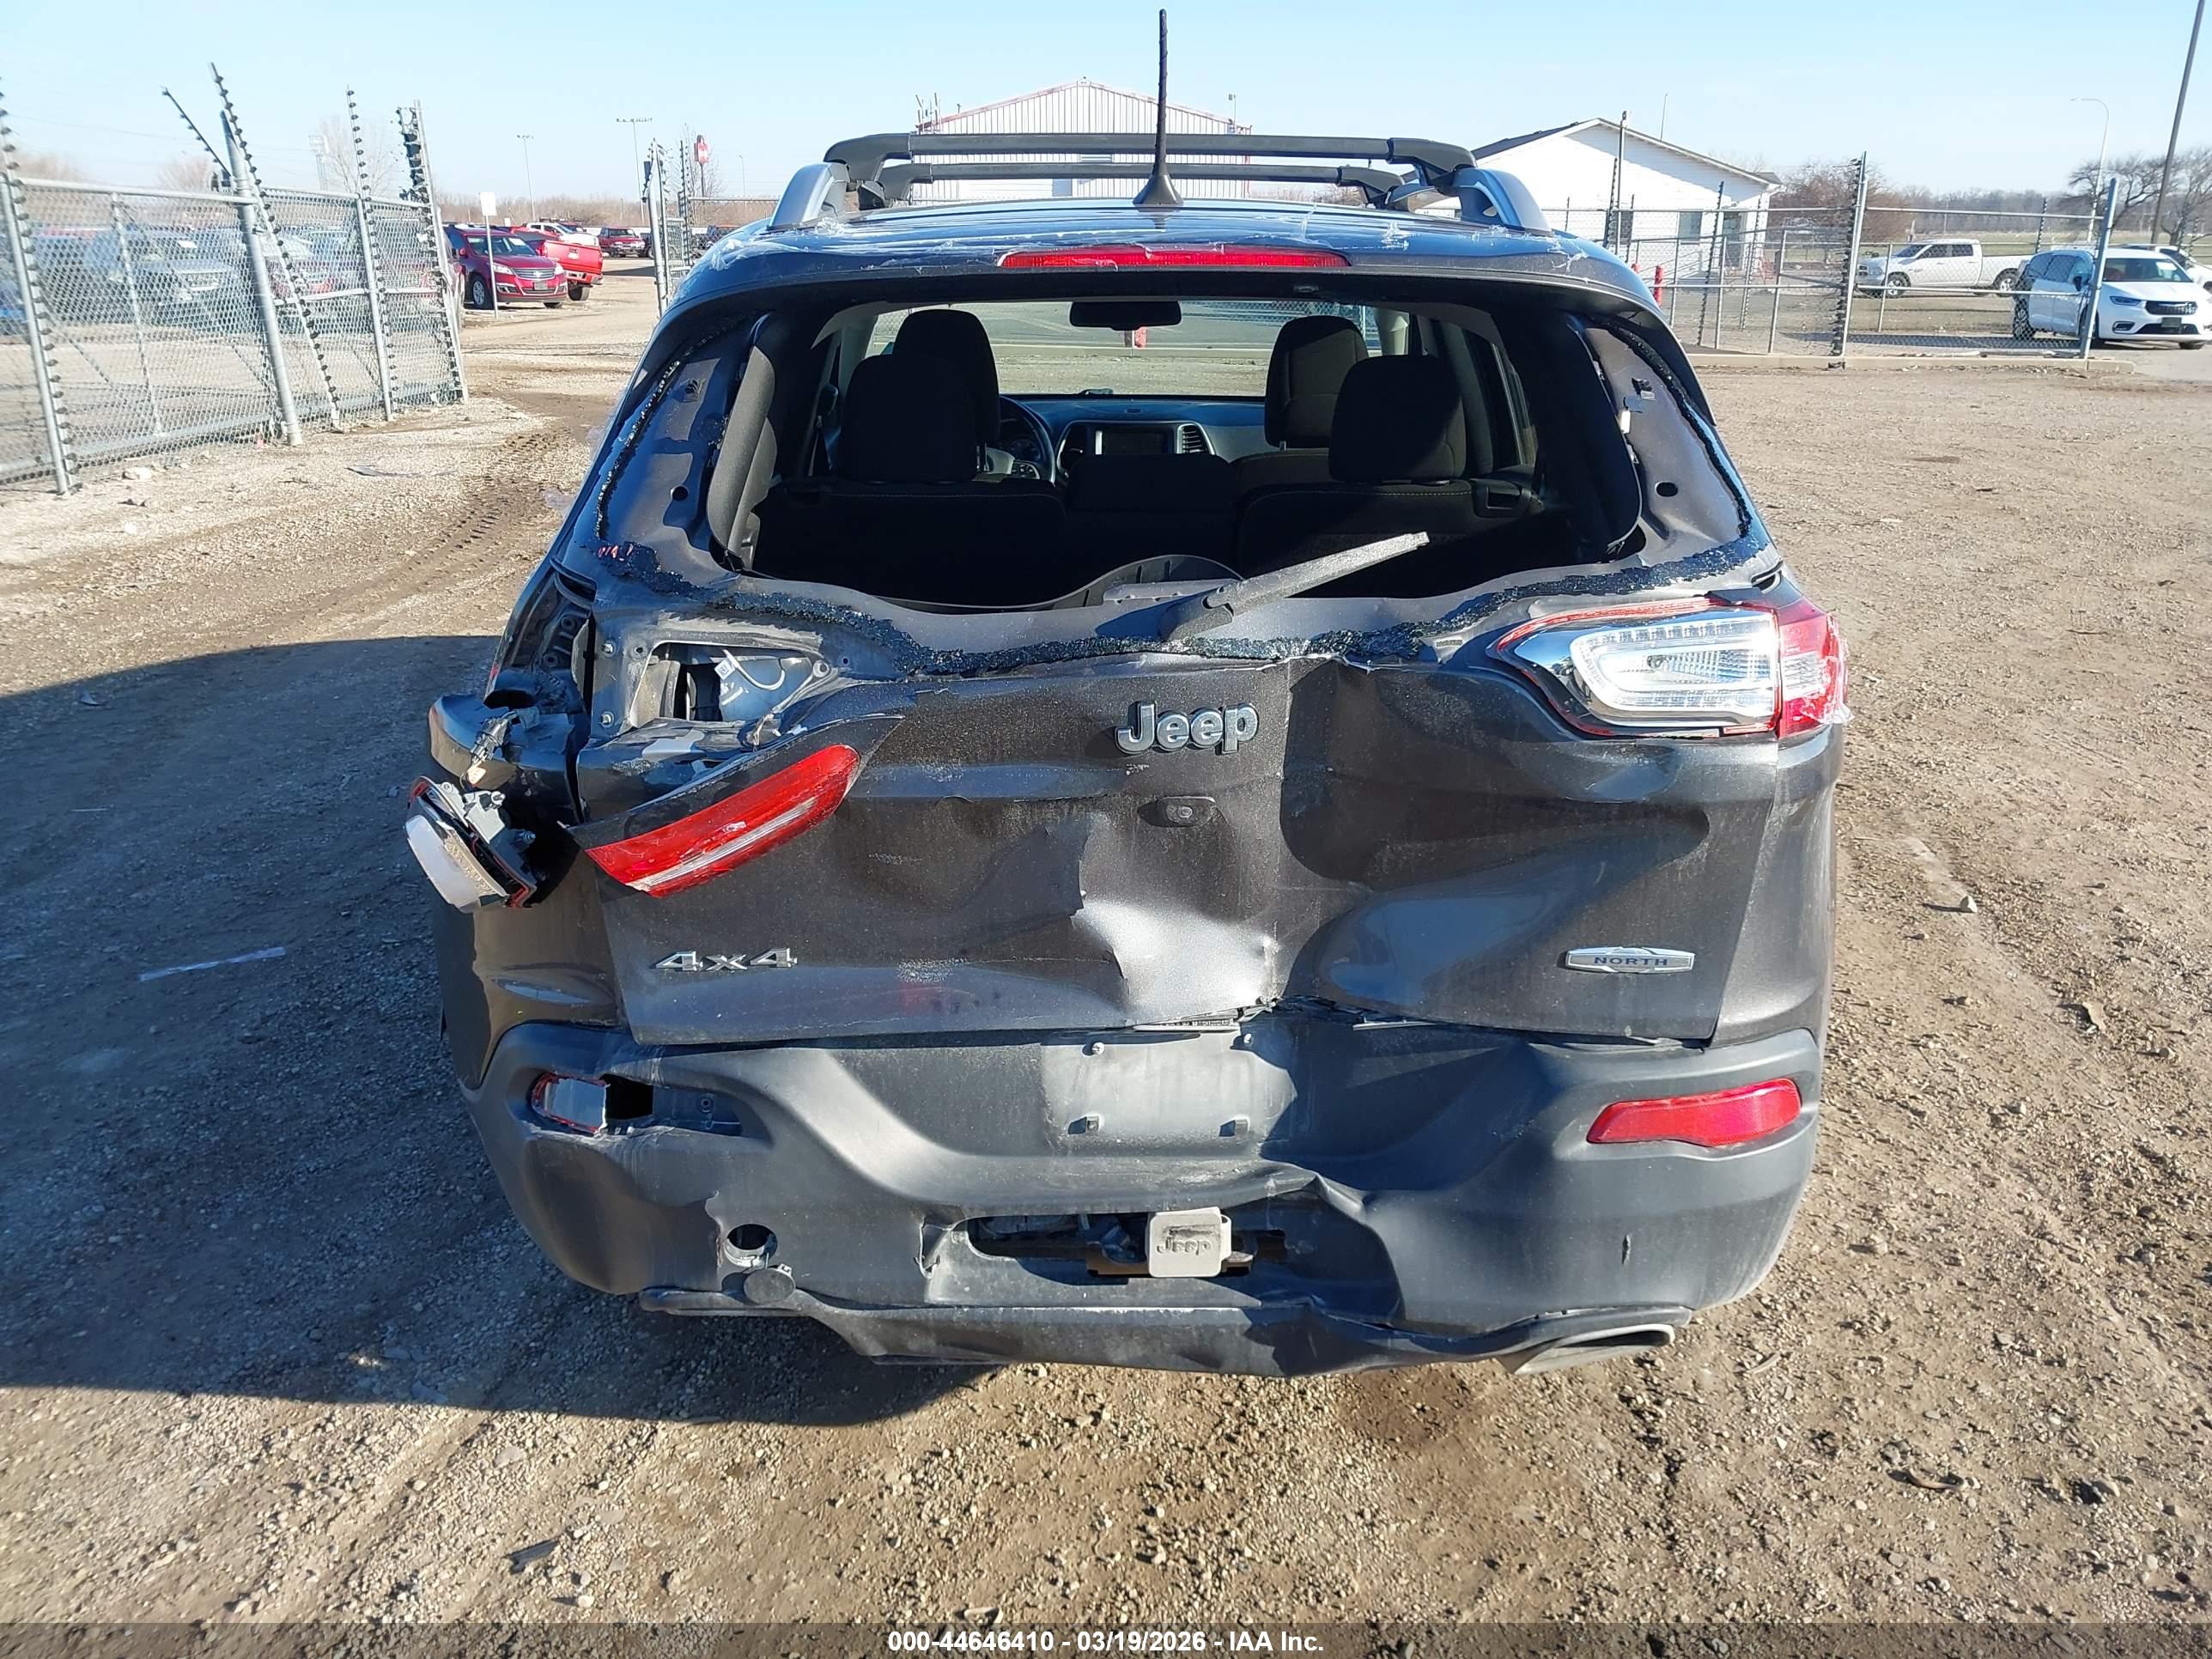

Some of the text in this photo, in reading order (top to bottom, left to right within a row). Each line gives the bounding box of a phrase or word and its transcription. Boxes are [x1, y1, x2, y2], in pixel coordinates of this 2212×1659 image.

[1115, 700, 1259, 756] Jeep
[1594, 957, 1668, 966] NORTH
[1156, 1236, 1212, 1255] Jeep
